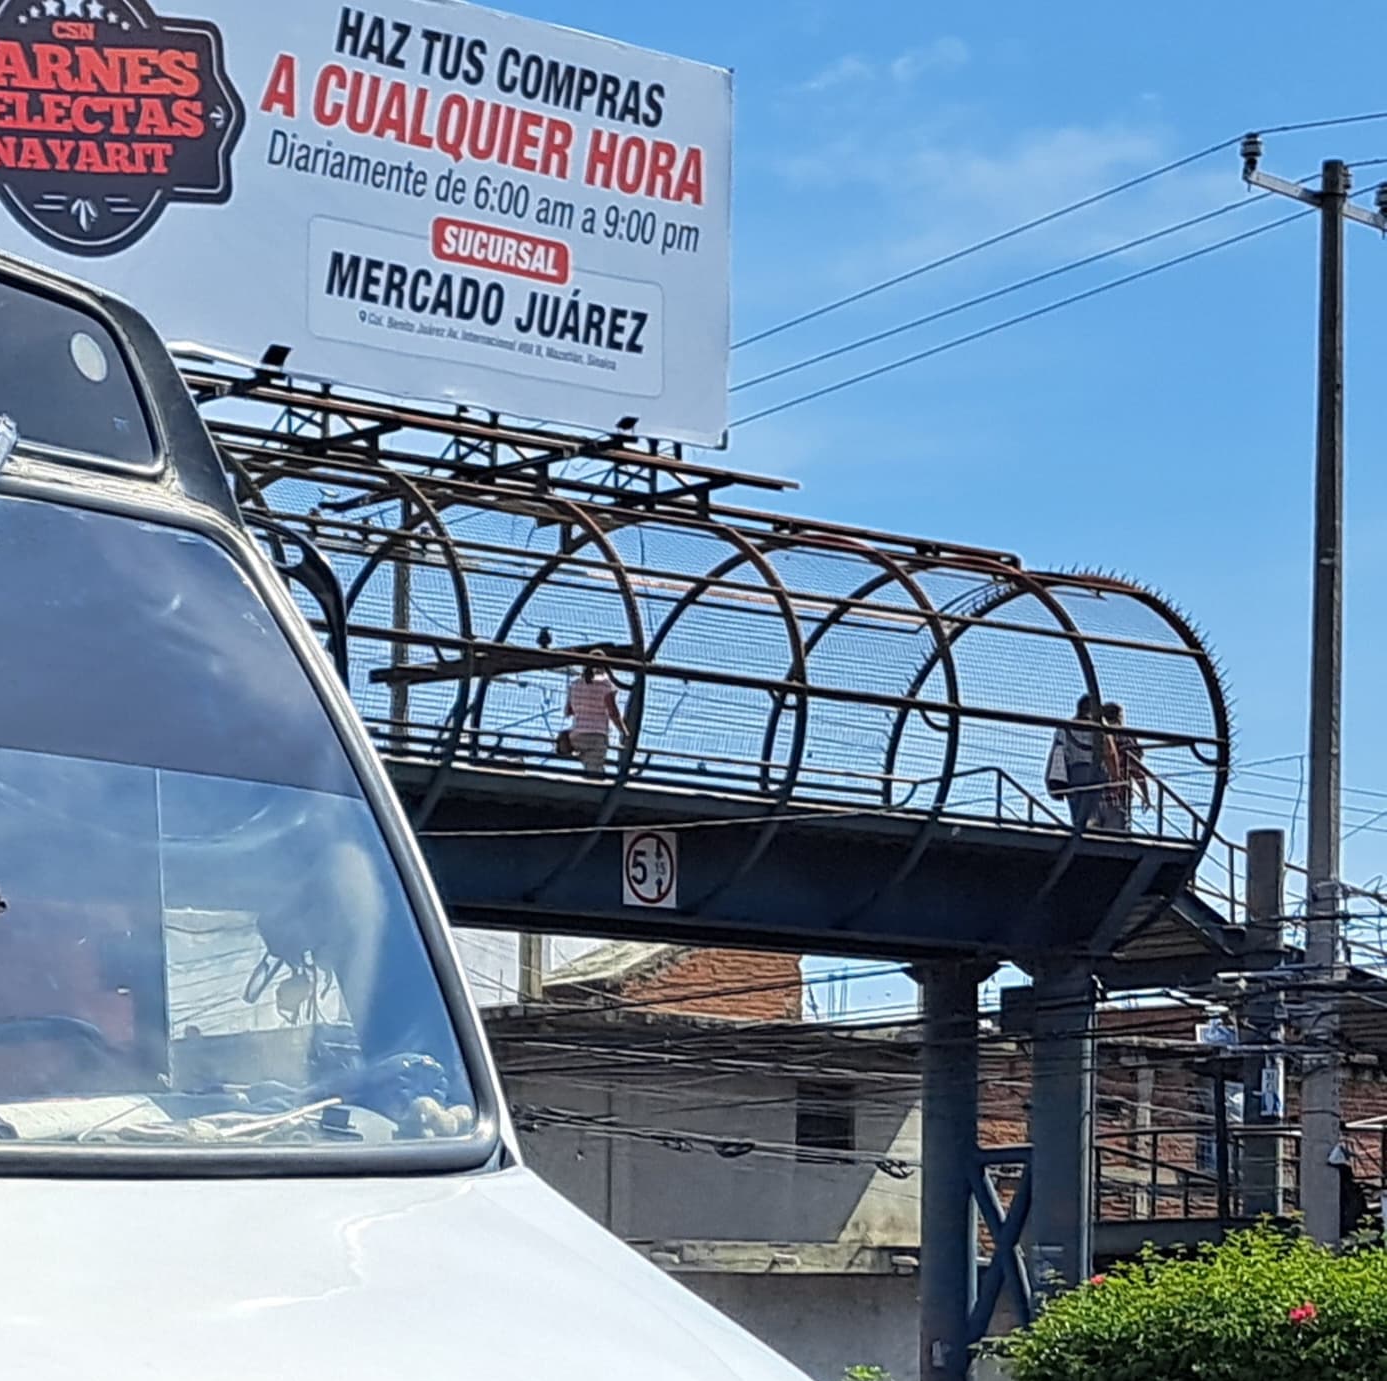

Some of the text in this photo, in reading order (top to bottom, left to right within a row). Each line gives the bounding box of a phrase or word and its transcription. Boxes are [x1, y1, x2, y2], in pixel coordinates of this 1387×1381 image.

[52, 20, 96, 41] CSN
[335, 6, 666, 128] HAZ TUS COMPRAS
[260, 53, 703, 205] A CUALQUIER HORA
[268, 128, 700, 255] Diariamente de 6:00 am a 9:00 pm
[325, 250, 649, 354] MERCADO JUÁREZ
[441, 224, 559, 277] SUCURSAL
[631, 850, 648, 885] 5
